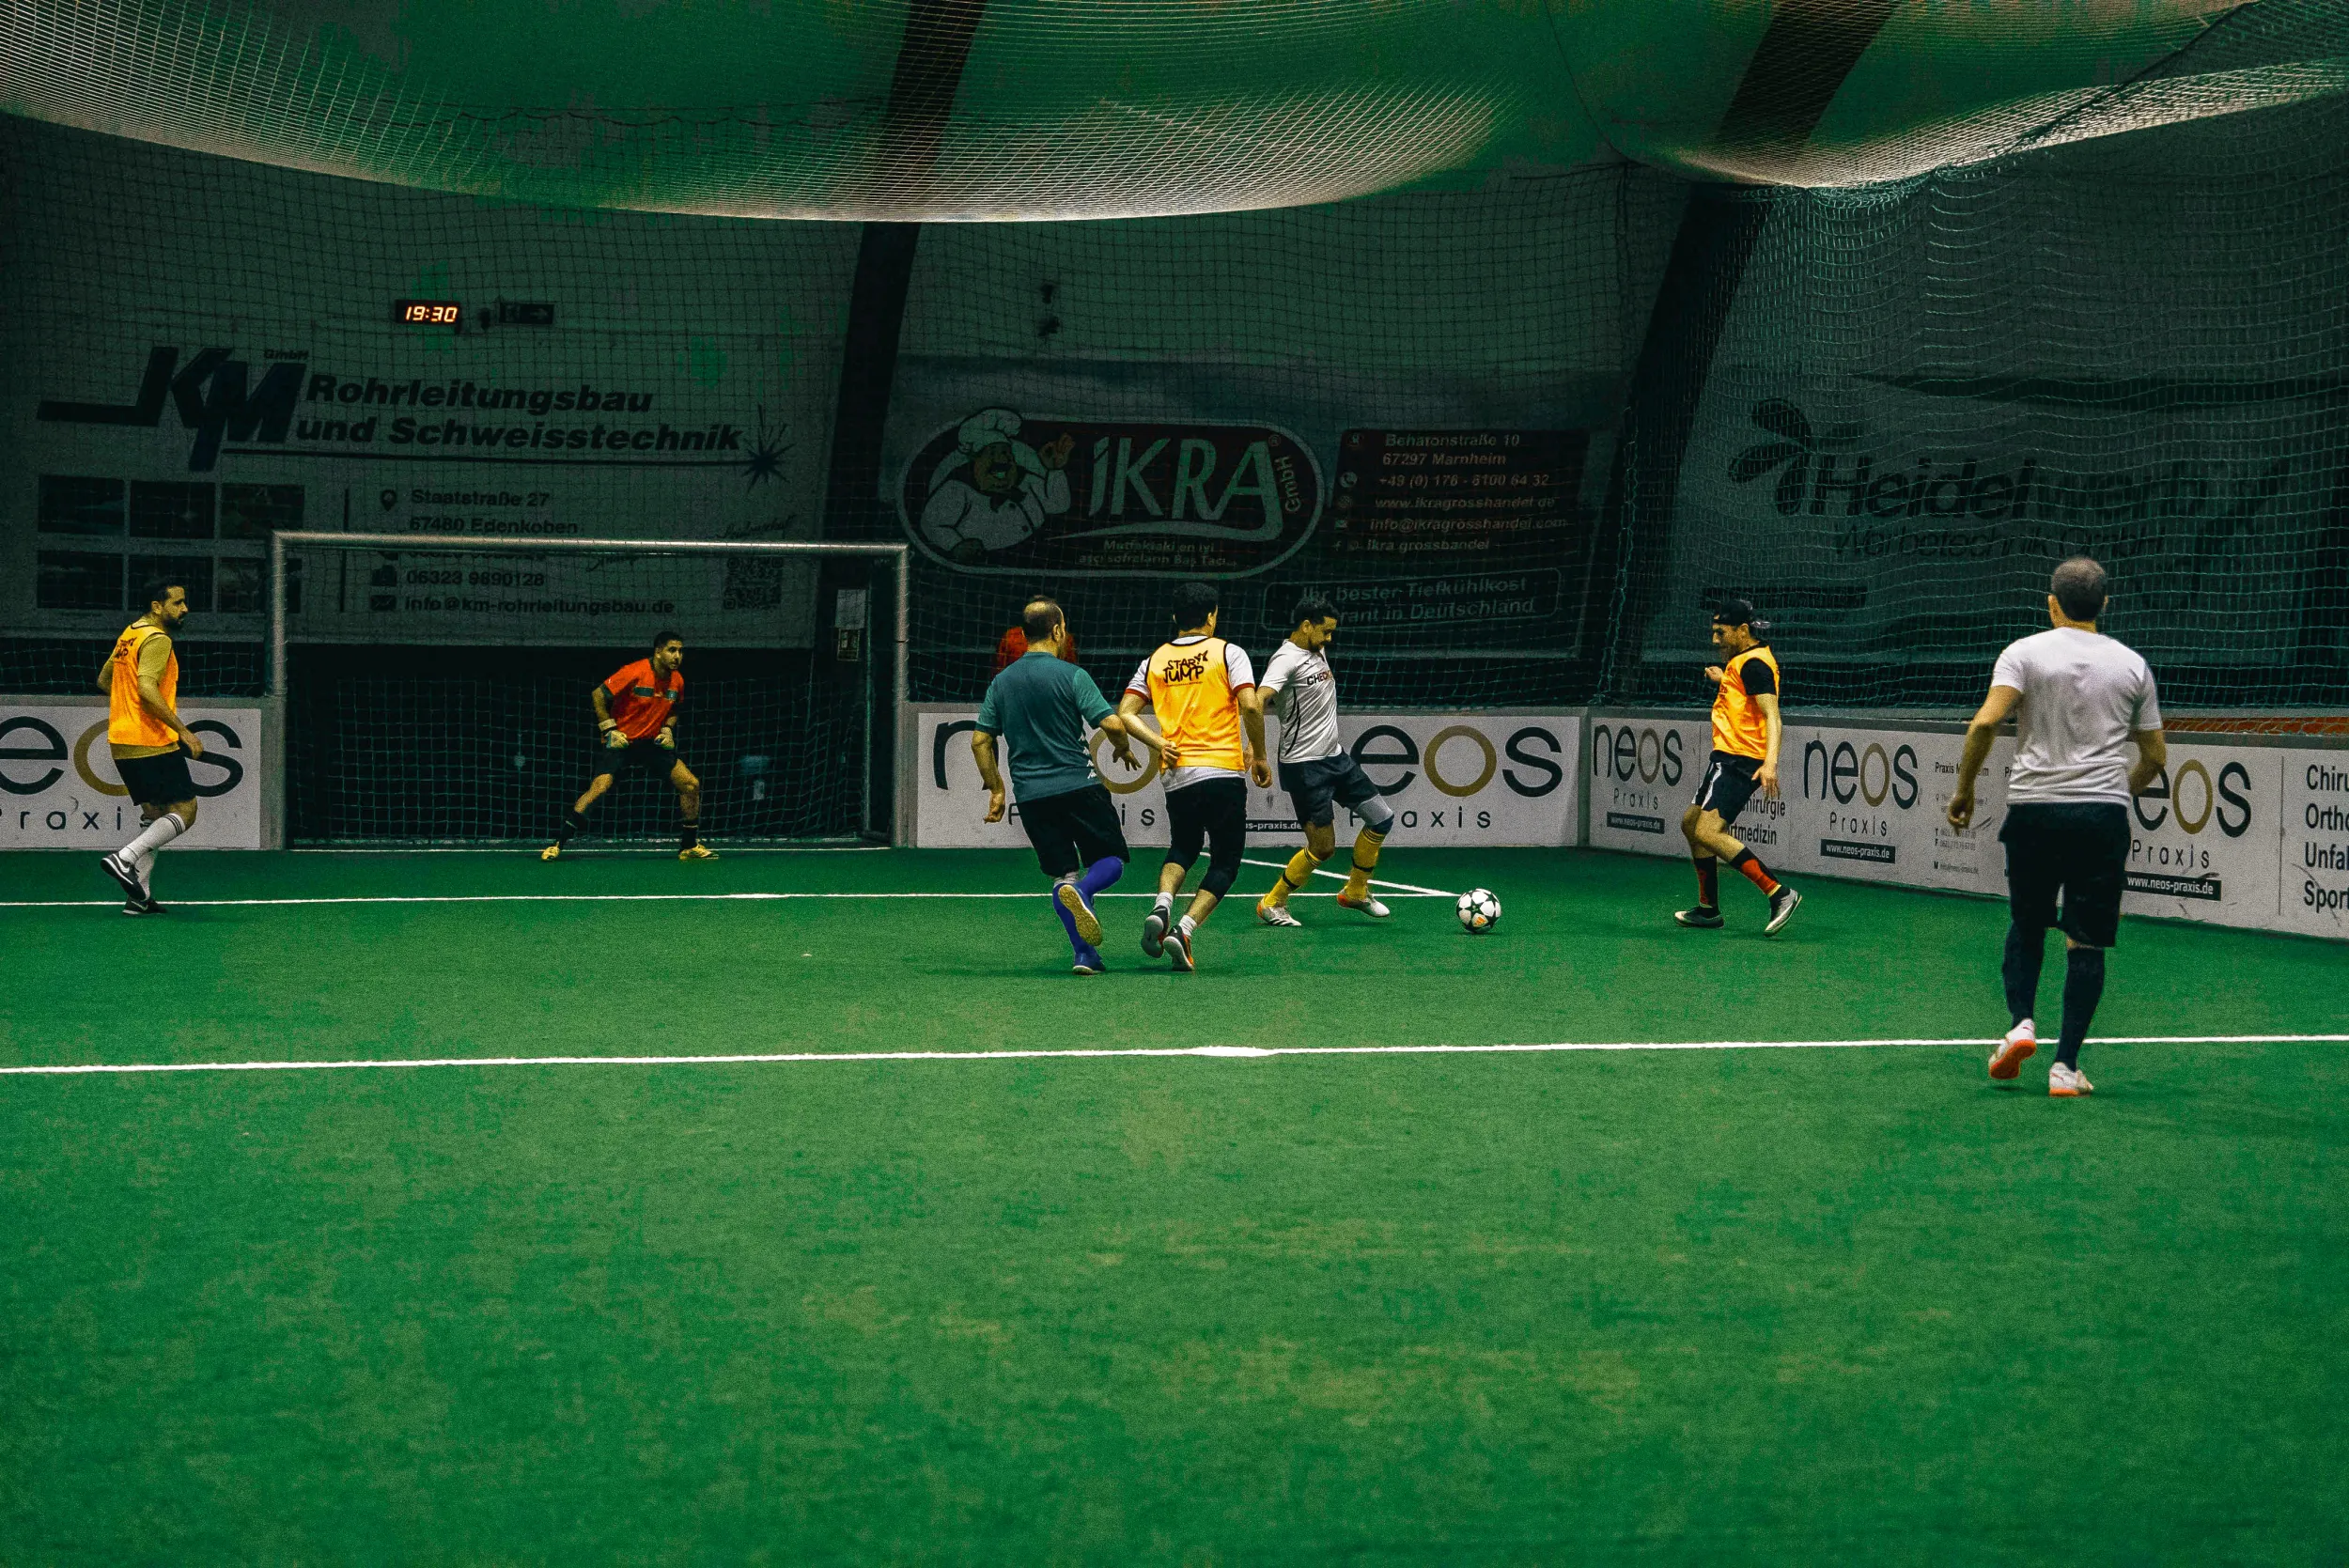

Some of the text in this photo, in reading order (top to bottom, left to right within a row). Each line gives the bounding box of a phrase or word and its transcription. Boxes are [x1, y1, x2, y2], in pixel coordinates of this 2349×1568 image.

[404, 304, 459, 323] 19:30
[306, 375, 654, 415] Rohrleitungsbau
[297, 417, 744, 452] und Schweisstechnik
[1502, 433, 1520, 447] 10
[1382, 452, 1507, 466] 67297 Marnheim
[1274, 455, 1303, 514] GmbH
[1378, 474, 1406, 487] +49
[411, 489, 551, 506] Staatstraße 27
[409, 517, 578, 534] 67480 Edenkoben
[407, 570, 463, 585] 06323
[1335, 585, 1401, 602] bester
[1408, 577, 1527, 598] Tiefkühlkost
[1382, 605, 1403, 620] in
[1409, 597, 1535, 620] Deutschland
[1162, 665, 1205, 684] JUMP
[1167, 659, 1197, 670] STAR
[1349, 724, 1563, 798] eos
[1593, 723, 1684, 787] neos
[1803, 739, 1920, 810] neos
[1935, 762, 1954, 774] Praxis
[1613, 787, 1659, 811] Praxis
[2132, 758, 2252, 838] eos
[1349, 805, 1492, 829] Paxis
[1829, 811, 1889, 836] Praxis
[1826, 844, 1890, 860] www.neos-praxis.de
[2132, 839, 2210, 869] Praxis
[2127, 876, 2214, 895] www.neos-praxis.de
